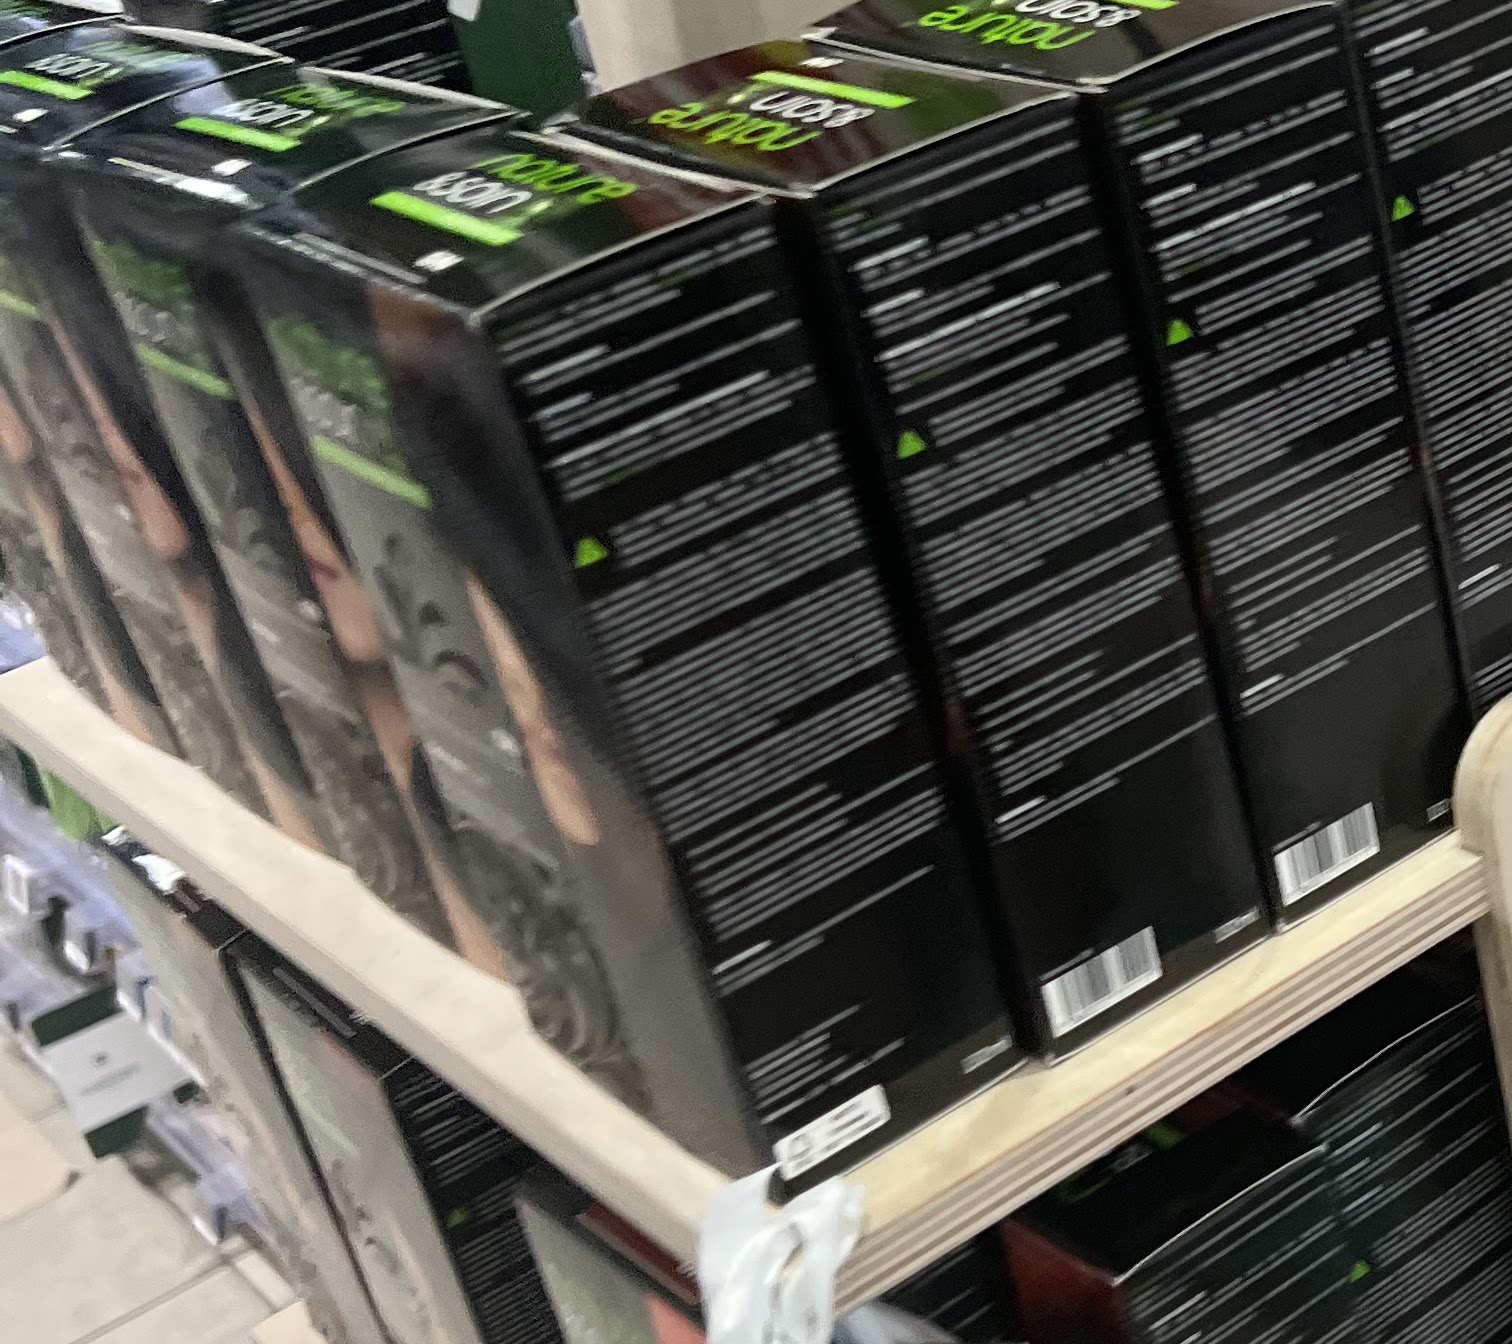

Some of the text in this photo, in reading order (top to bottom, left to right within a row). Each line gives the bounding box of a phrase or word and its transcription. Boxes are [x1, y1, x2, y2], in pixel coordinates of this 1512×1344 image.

[917, 4, 1098, 51] nature
[647, 101, 824, 152] nature
[748, 91, 876, 130] &soin
[410, 170, 534, 214] &soin
[475, 153, 639, 205] nature
